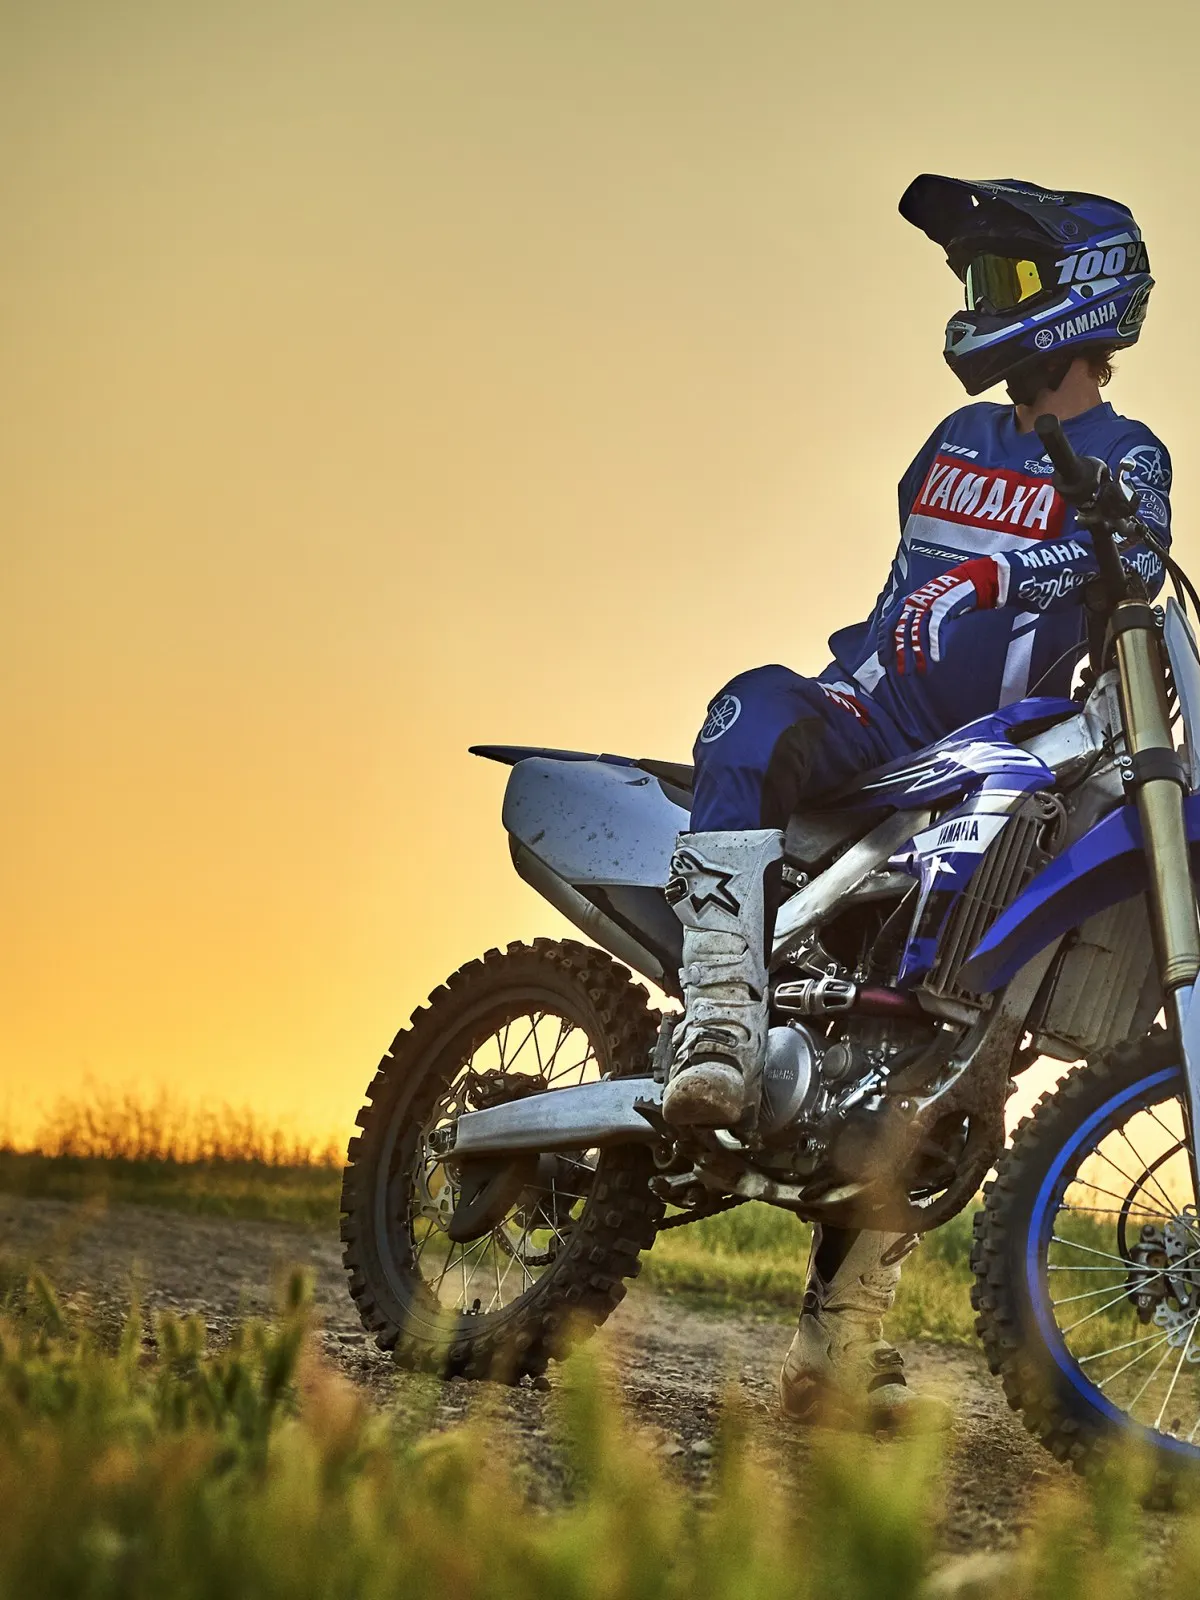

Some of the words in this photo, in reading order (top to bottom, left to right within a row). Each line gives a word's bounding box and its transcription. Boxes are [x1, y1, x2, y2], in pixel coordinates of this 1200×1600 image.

[1055, 243, 1146, 284] 100%
[1055, 301, 1117, 341] YAMAHA
[1014, 540, 1088, 568] MAHA
[937, 820, 979, 846] YAMAHA
